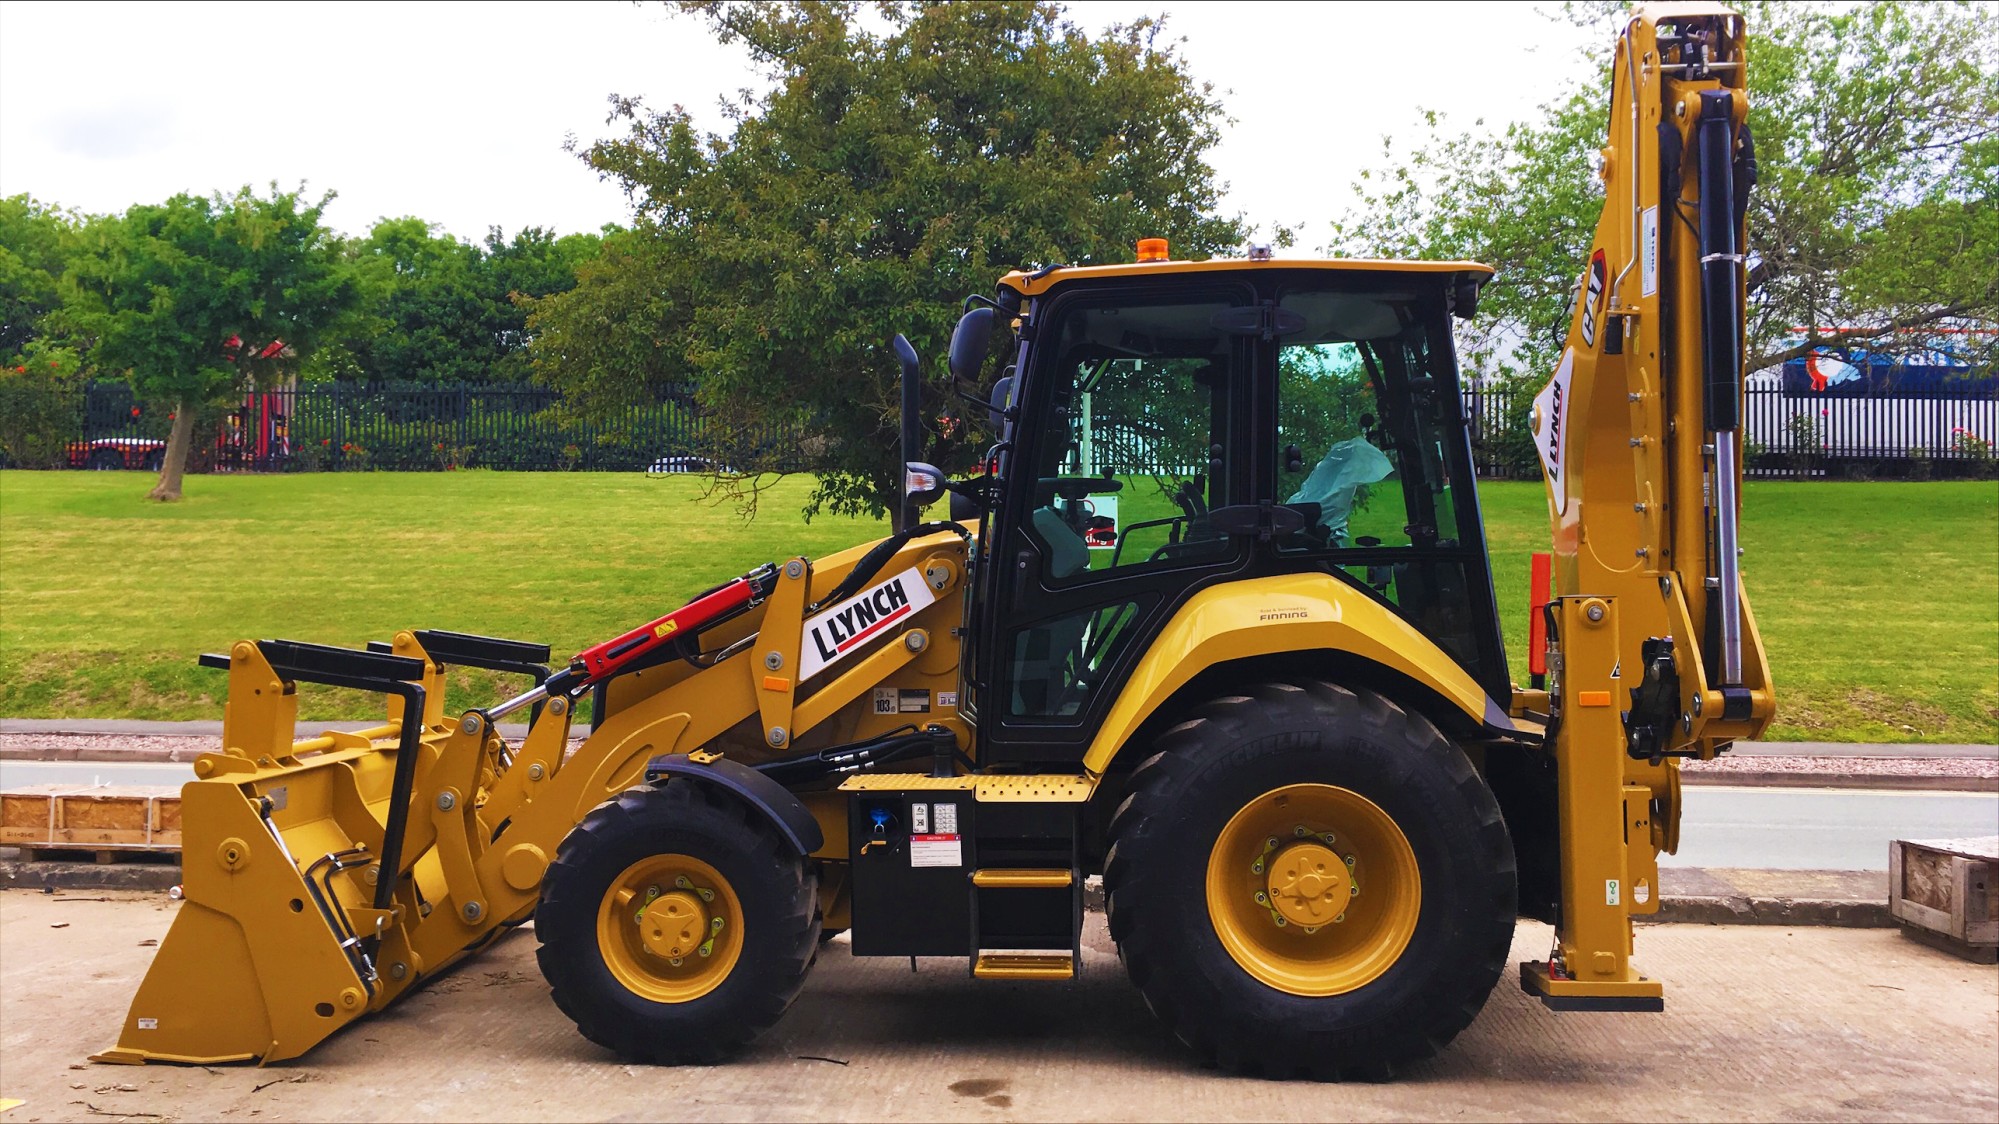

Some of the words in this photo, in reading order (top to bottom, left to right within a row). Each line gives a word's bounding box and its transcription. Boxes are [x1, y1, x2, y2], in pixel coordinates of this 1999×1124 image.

[1582, 264, 1602, 346] CAT
[1260, 612, 1308, 621] FINNING
[876, 699, 890, 712] 103
